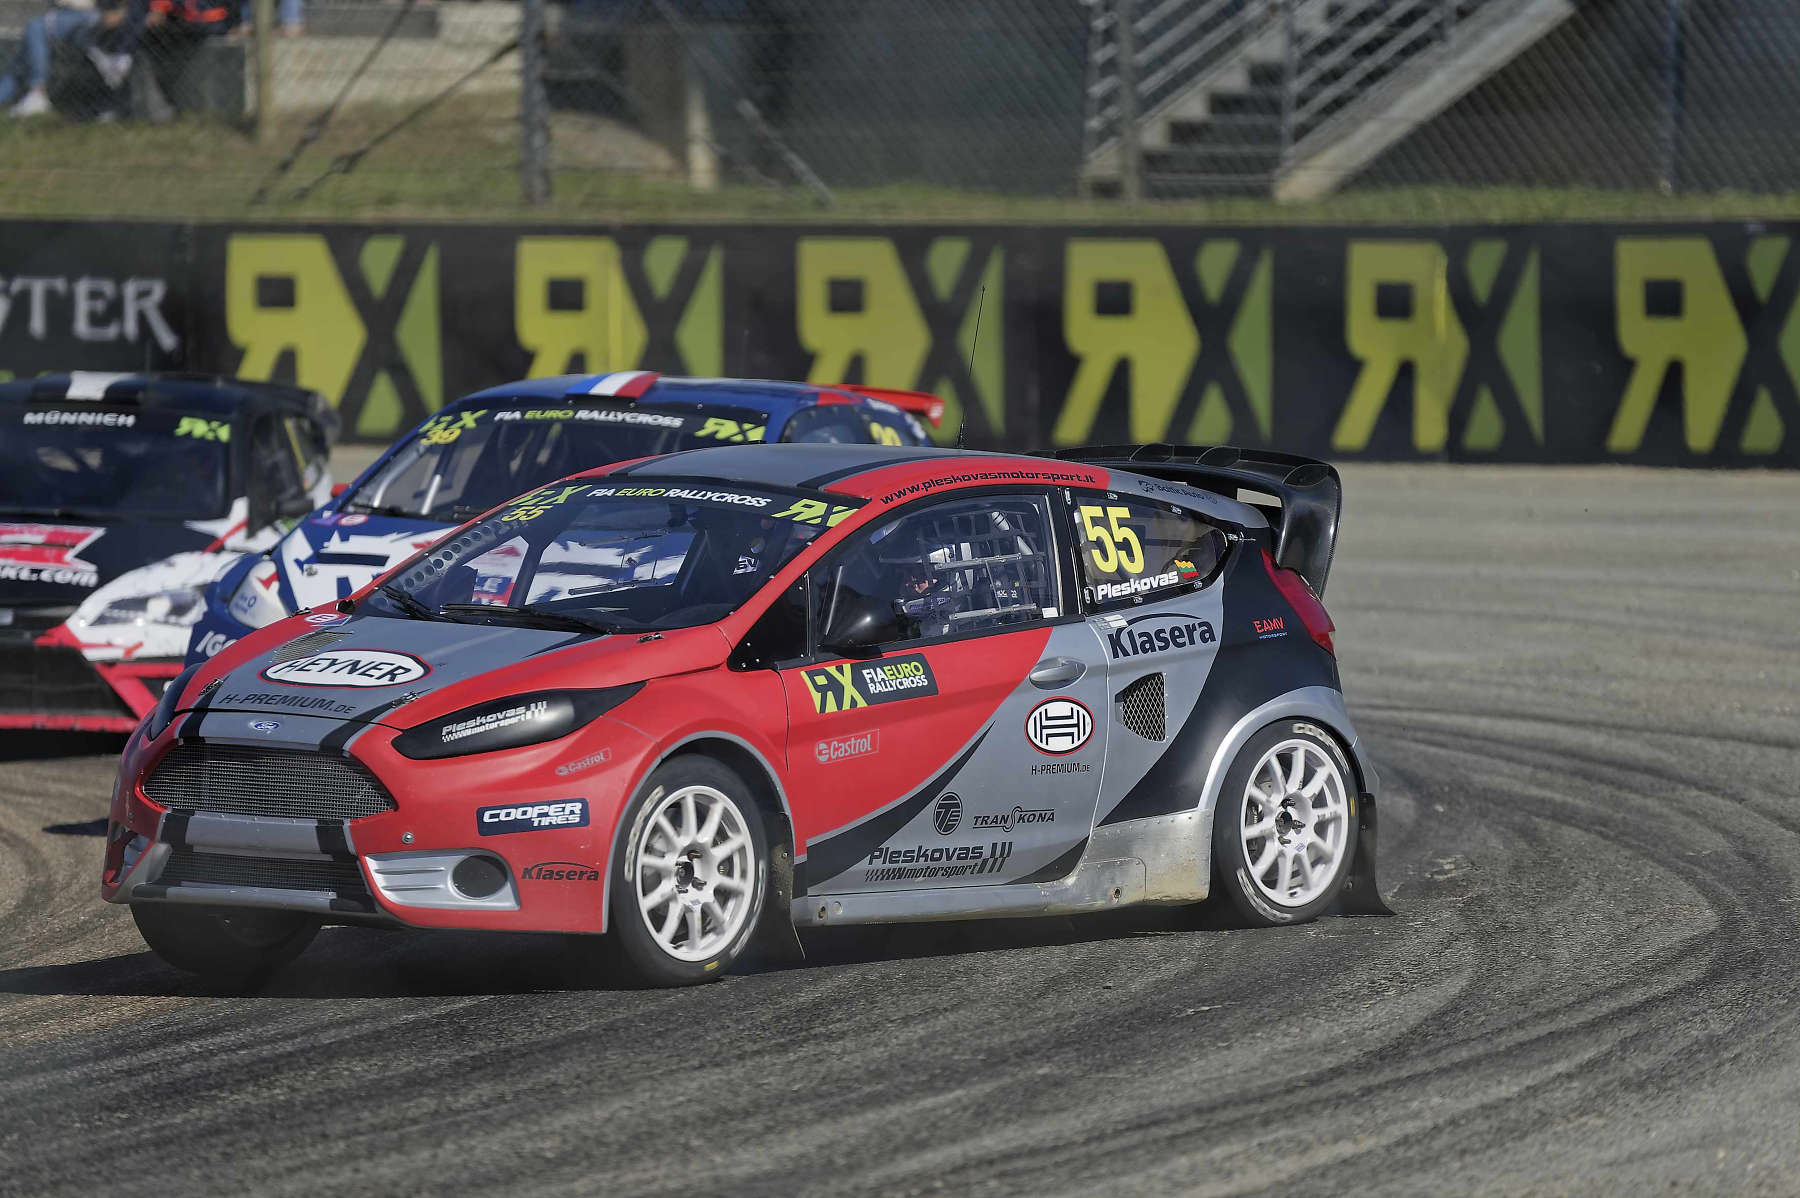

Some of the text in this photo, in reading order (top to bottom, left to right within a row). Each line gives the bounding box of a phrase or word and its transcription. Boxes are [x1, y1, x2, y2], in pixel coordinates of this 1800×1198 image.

[494, 410, 685, 428] FIA EURO RALLYCROSS
[587, 488, 773, 507] FIA EURO RALLYCROSS
[1079, 505, 1145, 574] 55
[1097, 570, 1179, 600] Pleskovas
[1107, 620, 1217, 660] Klasera
[273, 656, 412, 683] HEYNER
[868, 674, 929, 695] RALLYCROSS
[218, 693, 357, 715] H-PREMIUM.DE
[441, 706, 527, 737] Pleskovas
[830, 734, 872, 760] Castrol
[1031, 762, 1090, 776] H-PREMIUM.DE
[483, 802, 583, 824] COOPER
[531, 815, 581, 827] TIRES
[868, 845, 984, 866] Pleskovas
[521, 866, 600, 882] Klasera
[903, 862, 979, 881] motorsport
